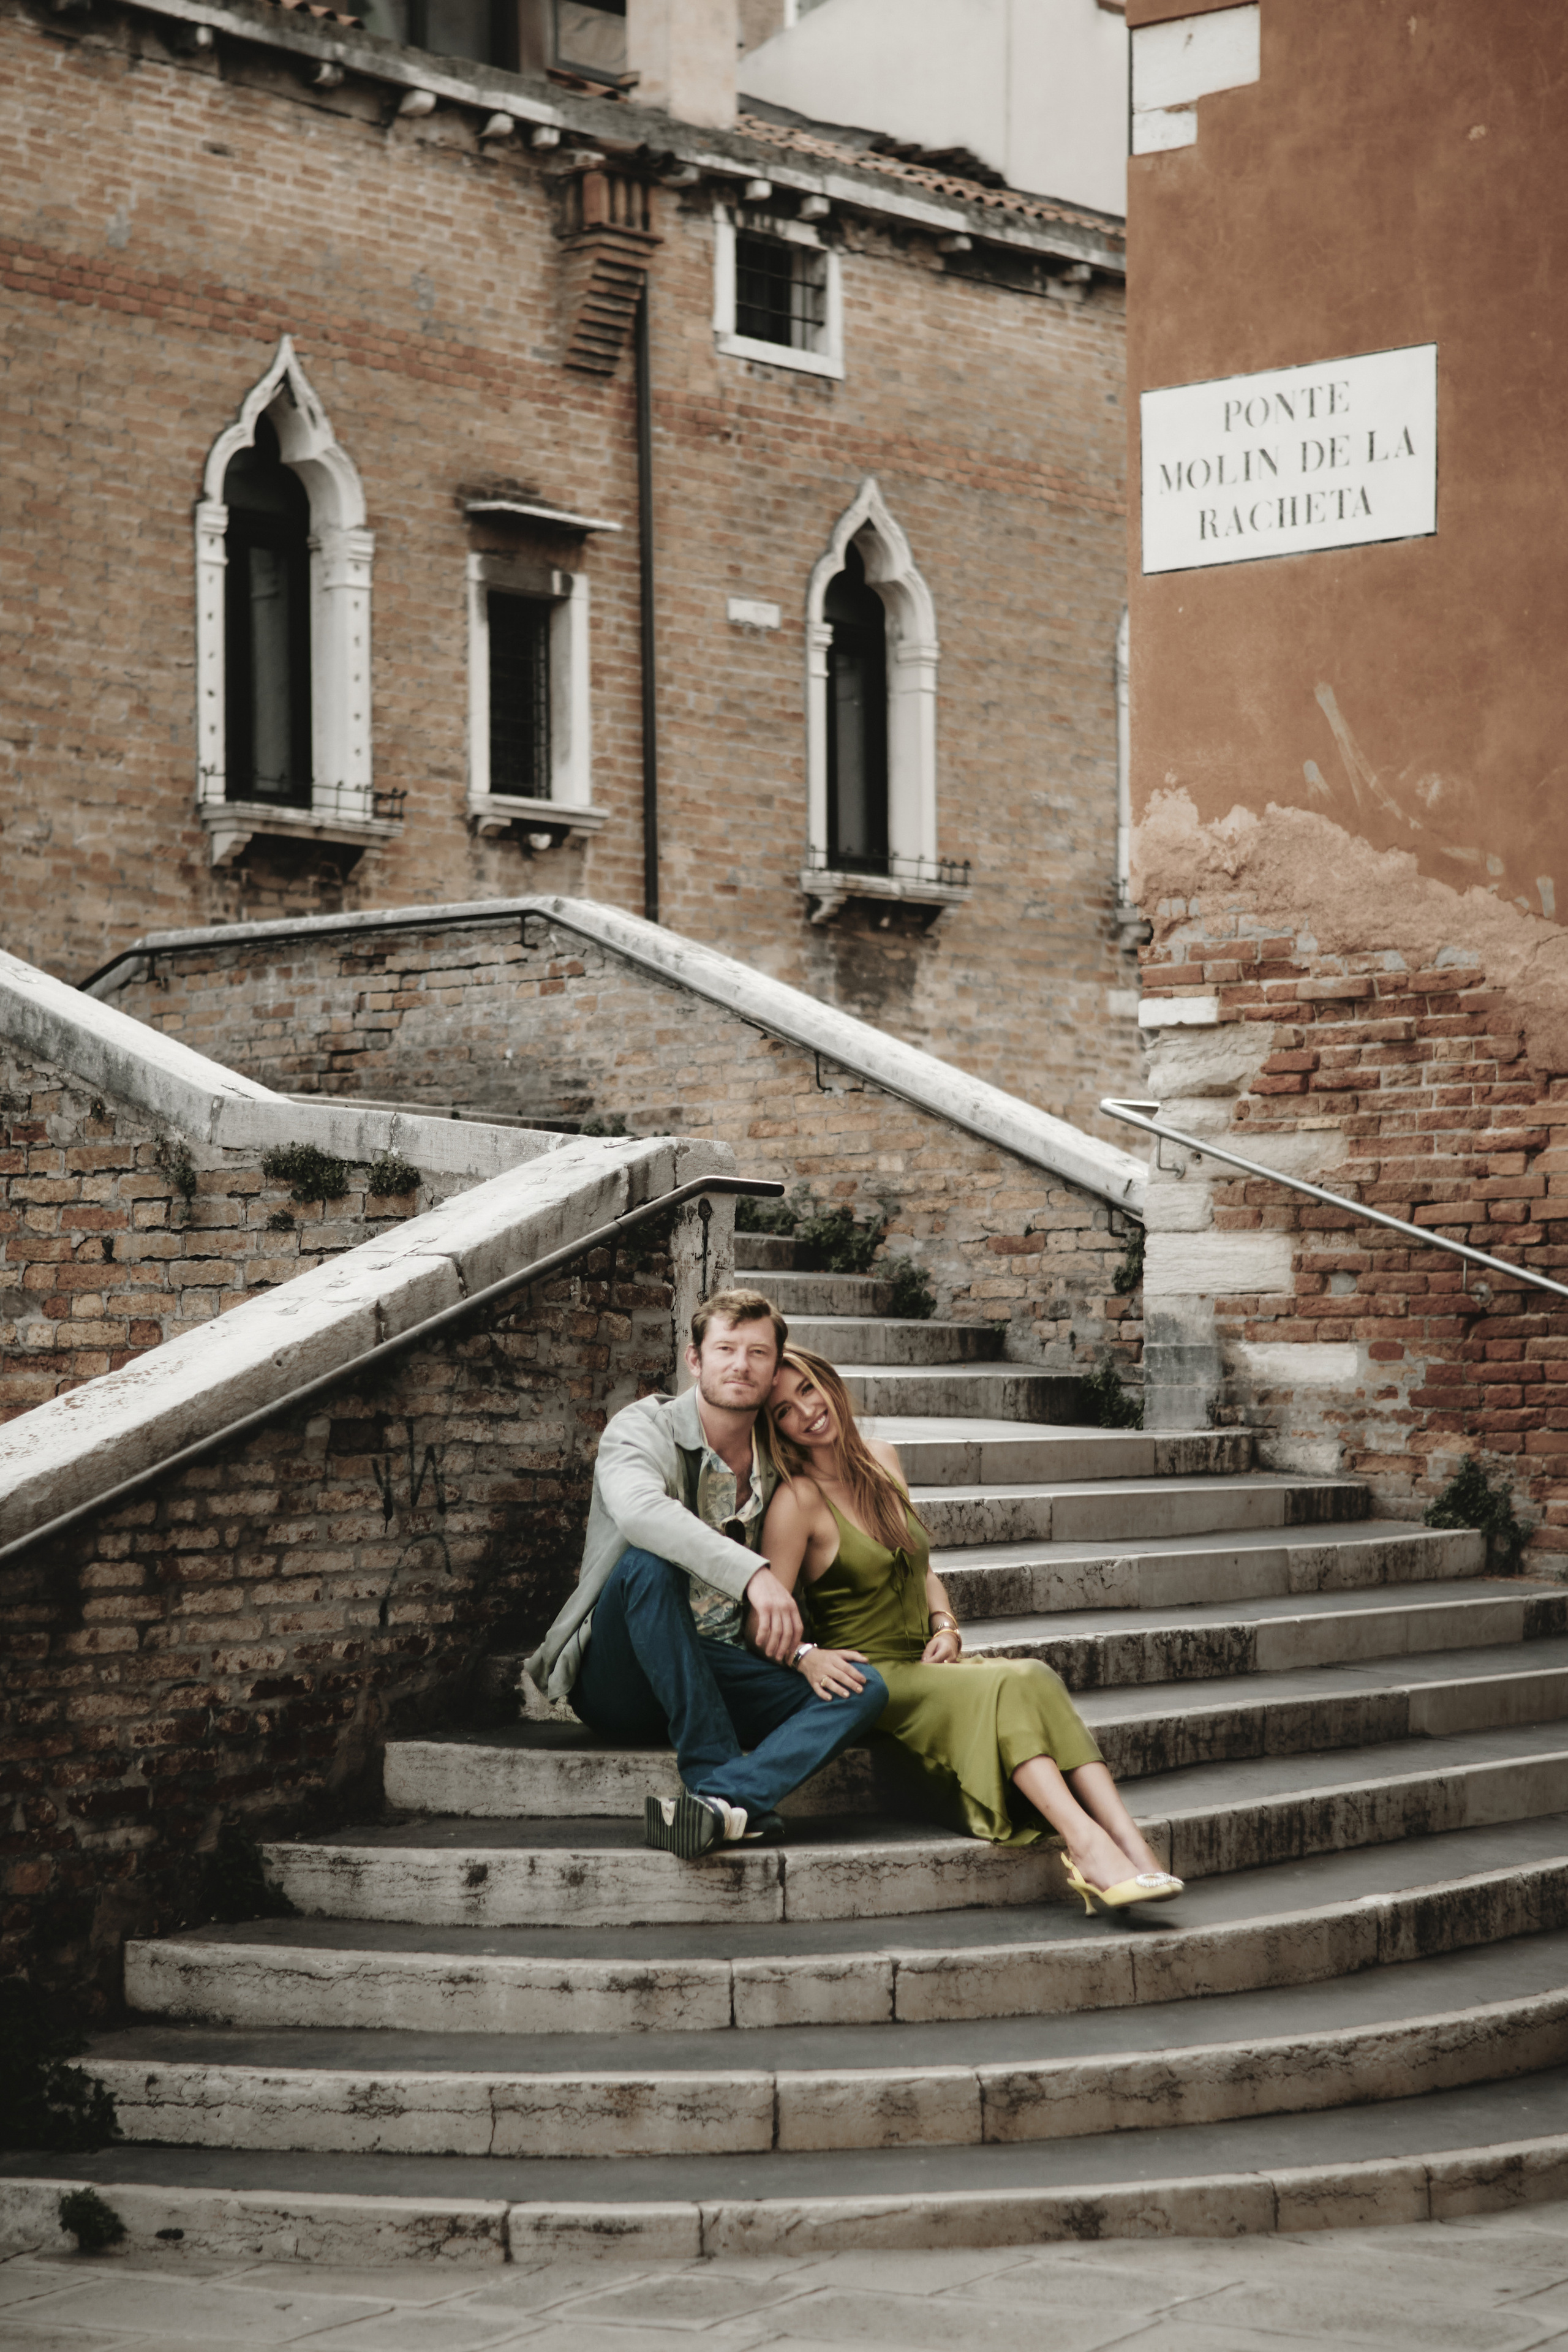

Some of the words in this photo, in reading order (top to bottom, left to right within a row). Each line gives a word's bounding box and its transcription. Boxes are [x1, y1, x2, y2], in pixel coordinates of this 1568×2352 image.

[1224, 380, 1350, 432] PONTE
[1159, 445, 1279, 495] MOLIN
[1301, 435, 1350, 473] DE
[1367, 426, 1416, 463] LA
[1199, 484, 1373, 540] RACHETA
